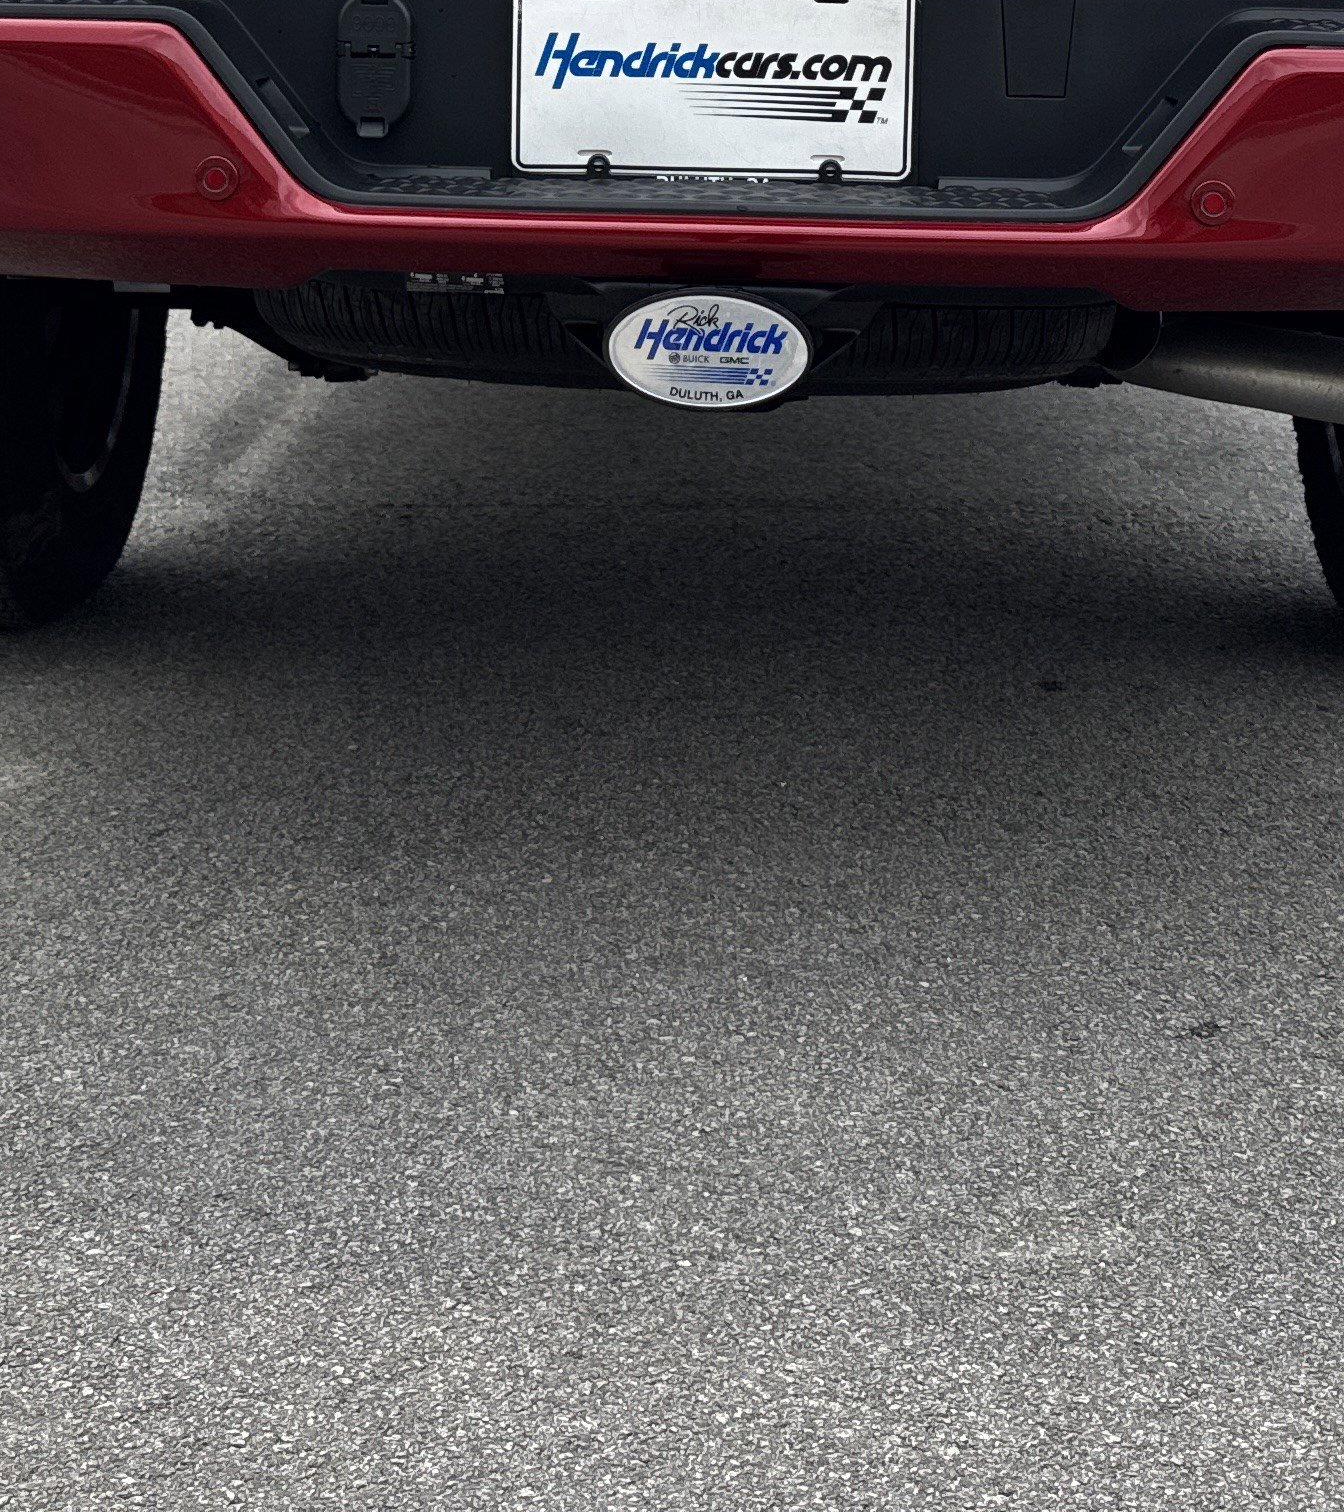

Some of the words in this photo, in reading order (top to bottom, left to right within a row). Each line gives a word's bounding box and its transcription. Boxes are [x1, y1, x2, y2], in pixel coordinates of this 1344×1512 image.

[534, 32, 893, 90] Hendrickcars.com
[667, 304, 720, 336] Rick
[633, 318, 789, 360] Hendrick
[682, 355, 710, 364] BUICK
[719, 356, 750, 365] GMC
[669, 386, 723, 403] DULUTH,
[726, 389, 745, 400] GA
